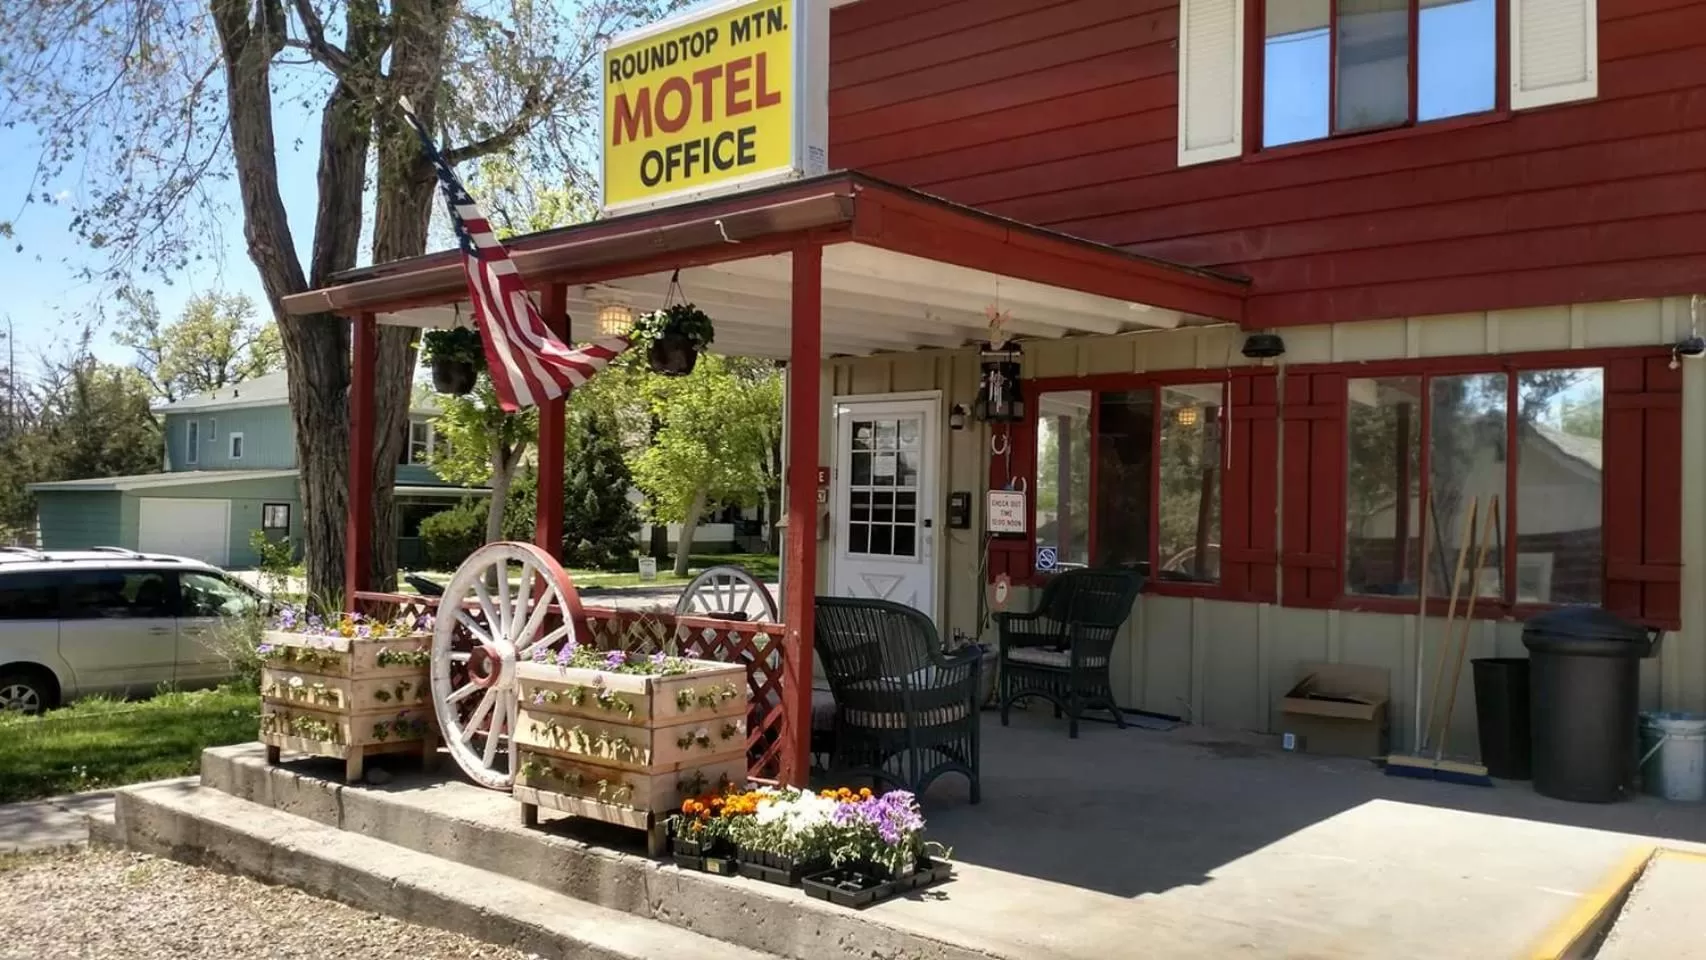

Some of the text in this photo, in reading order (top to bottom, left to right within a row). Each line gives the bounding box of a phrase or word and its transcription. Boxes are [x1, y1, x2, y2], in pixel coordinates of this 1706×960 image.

[609, 6, 788, 84] ROUNDTOP MTN.
[612, 51, 781, 147] MOTEL
[640, 125, 757, 187] OFFICE
[1001, 509, 1013, 517] TIME
[1011, 500, 1021, 508] OUT
